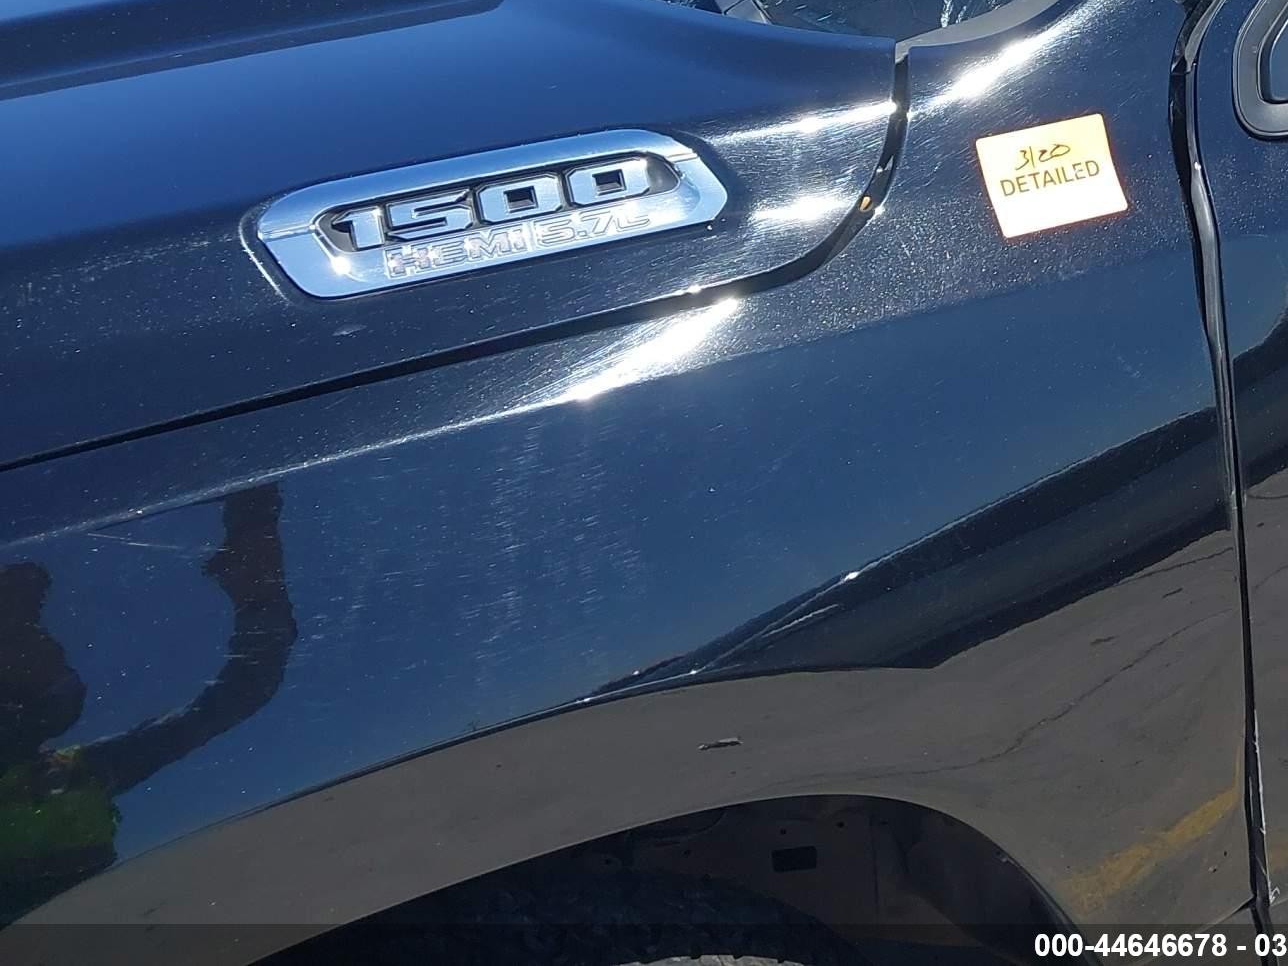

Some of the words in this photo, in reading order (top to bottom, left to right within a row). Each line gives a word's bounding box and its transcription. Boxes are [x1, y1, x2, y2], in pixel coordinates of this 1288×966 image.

[333, 156, 650, 250] 1500
[1000, 160, 1100, 197] DETAILED
[386, 226, 528, 278] HEMI
[535, 204, 651, 247] 5.7L
